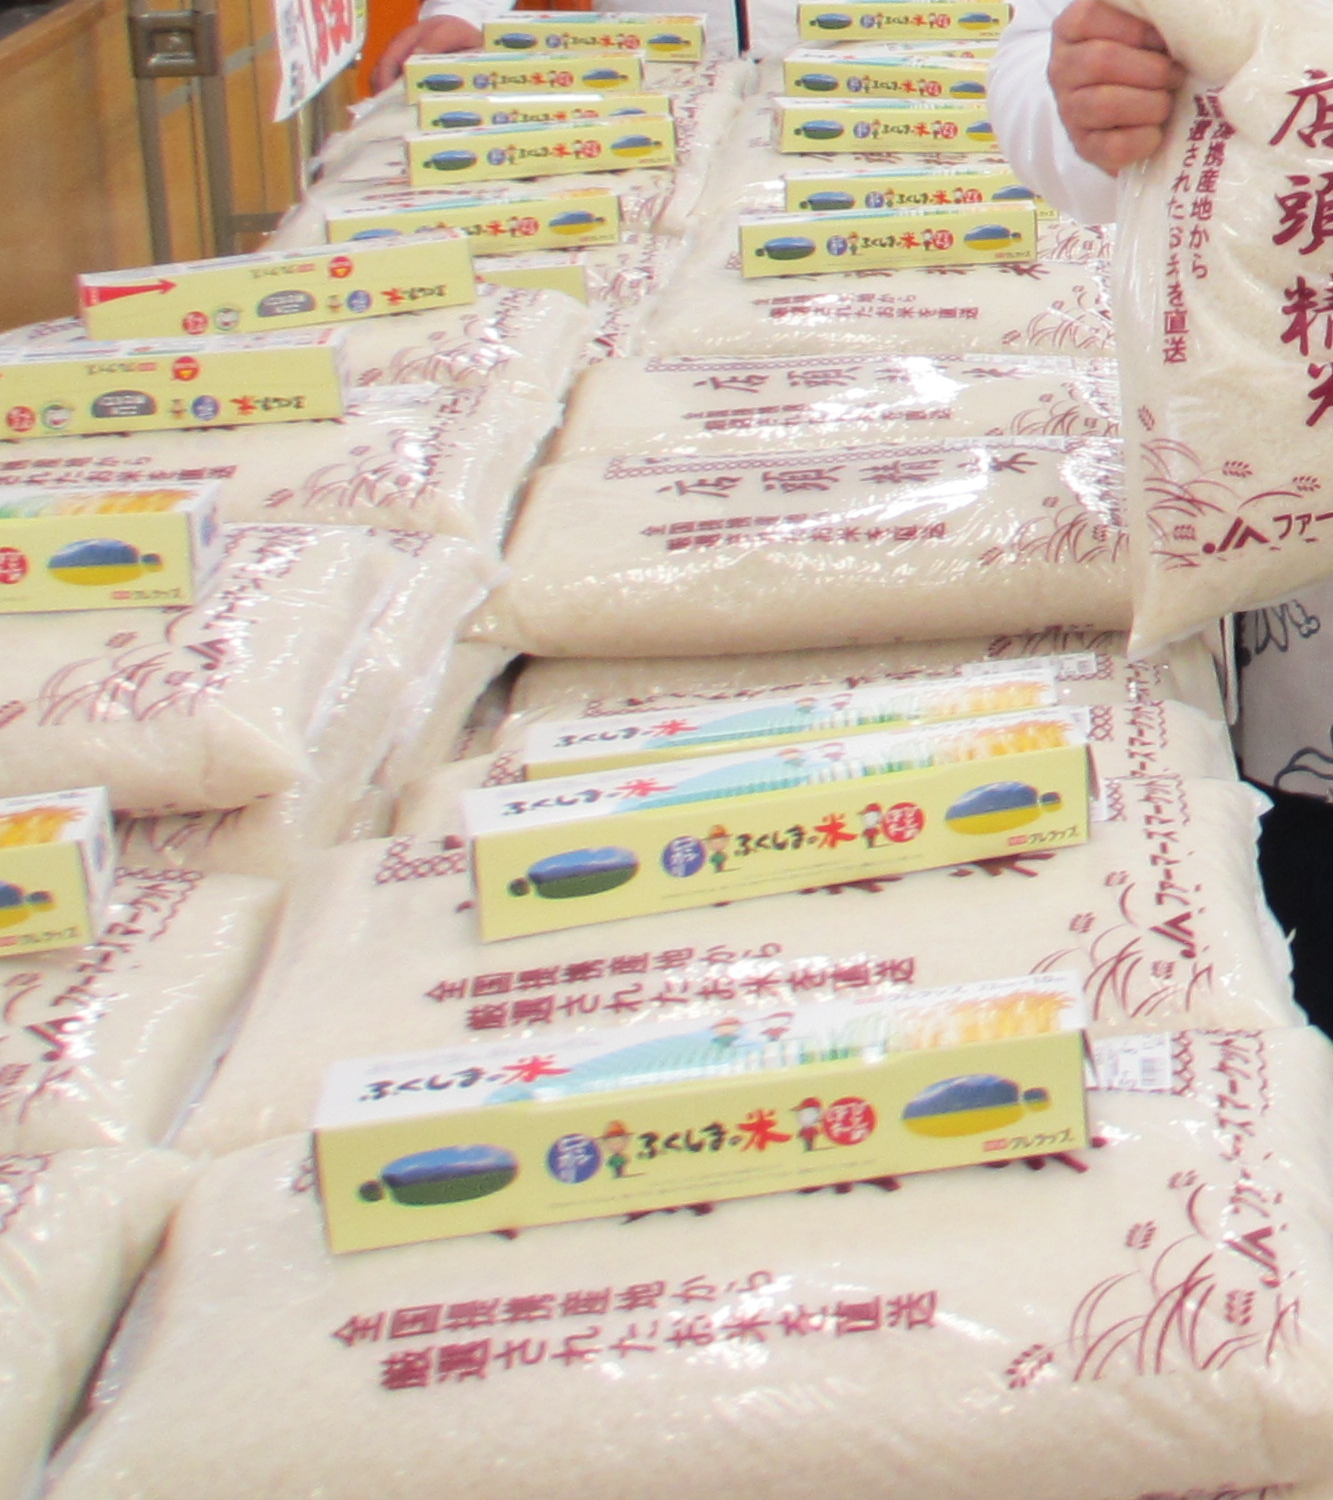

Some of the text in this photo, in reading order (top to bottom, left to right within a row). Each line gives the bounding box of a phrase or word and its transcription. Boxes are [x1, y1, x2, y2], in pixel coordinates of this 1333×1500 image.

[501, 776, 678, 817] ふくしまの米
[733, 812, 859, 858] ふくしまの米
[358, 1054, 573, 1103] ふくしまの米
[635, 1108, 793, 1161] ふくしまの米
[331, 1268, 773, 1349] 全国提携産地から
[379, 1289, 940, 1391] 厳選されたお米を直送
